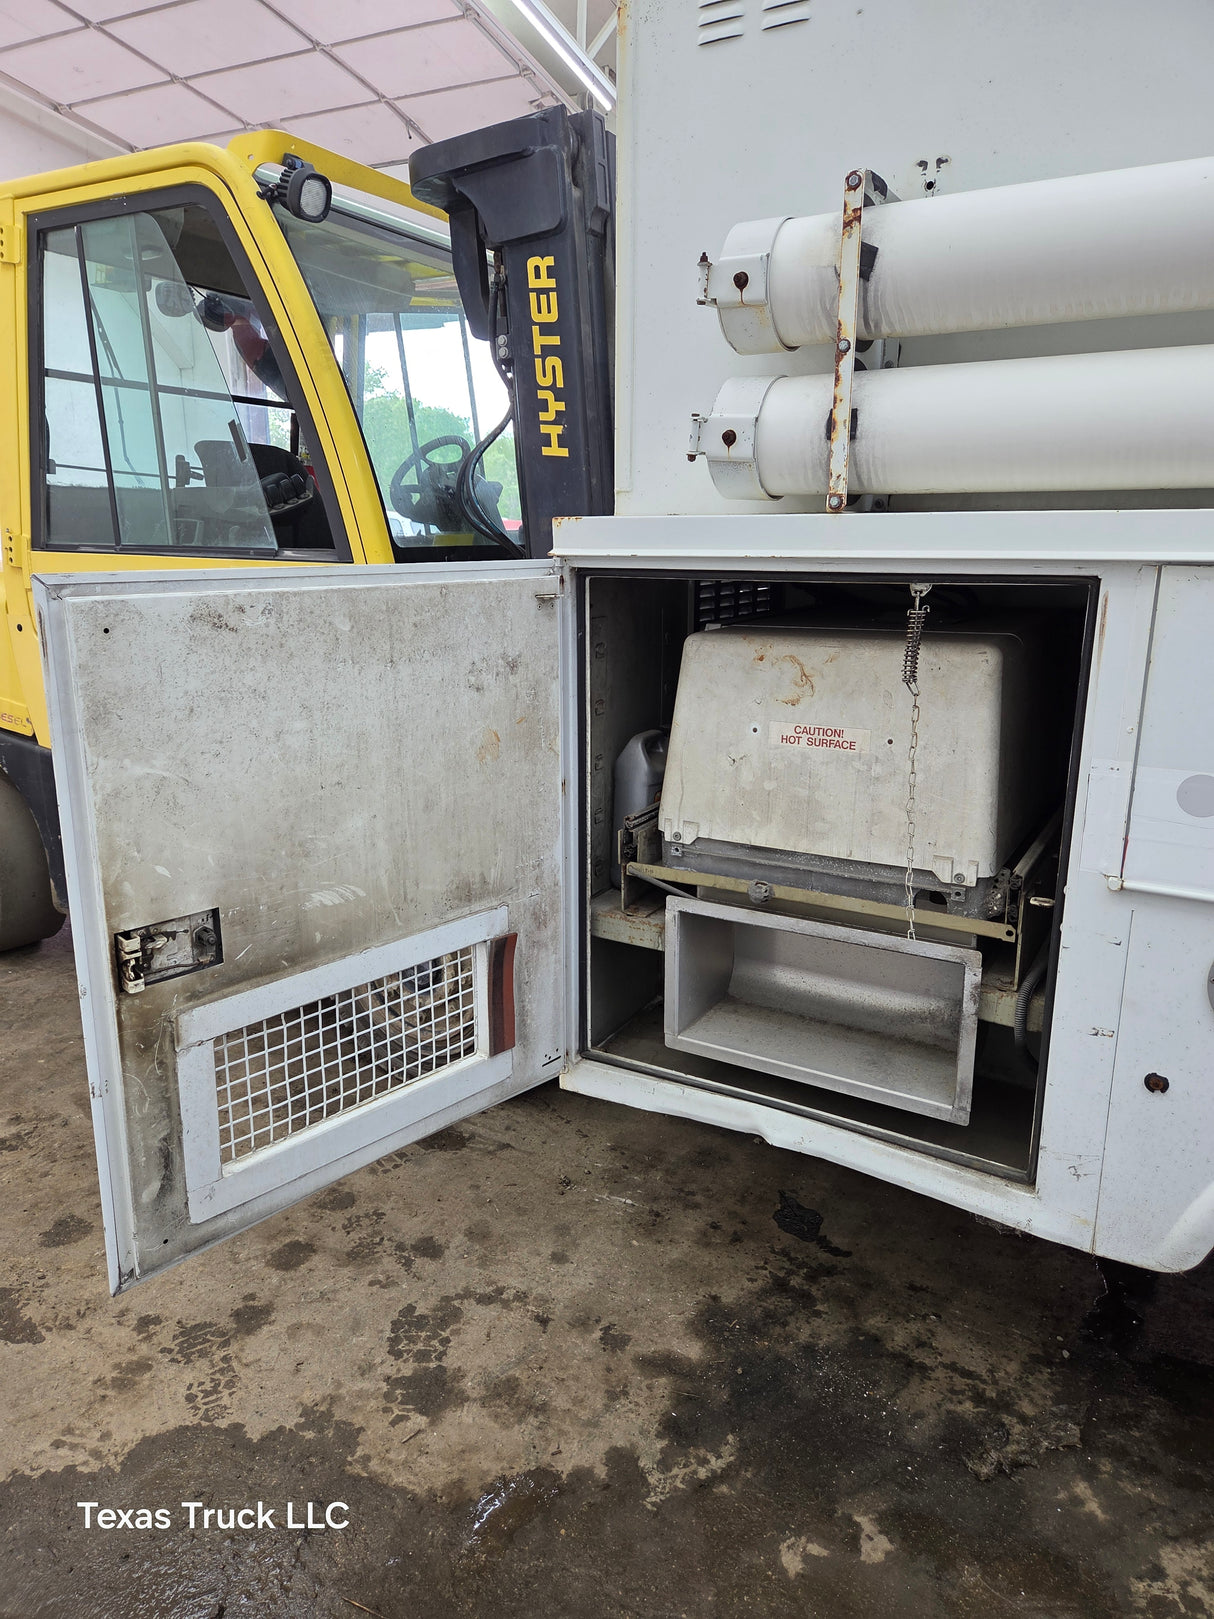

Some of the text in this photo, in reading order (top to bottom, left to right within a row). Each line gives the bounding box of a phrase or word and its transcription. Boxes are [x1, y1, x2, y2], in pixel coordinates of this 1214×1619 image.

[527, 256, 569, 457] HYSTER
[794, 725, 844, 738] CAUTION!
[781, 735, 856, 750] HOT SURFACE
